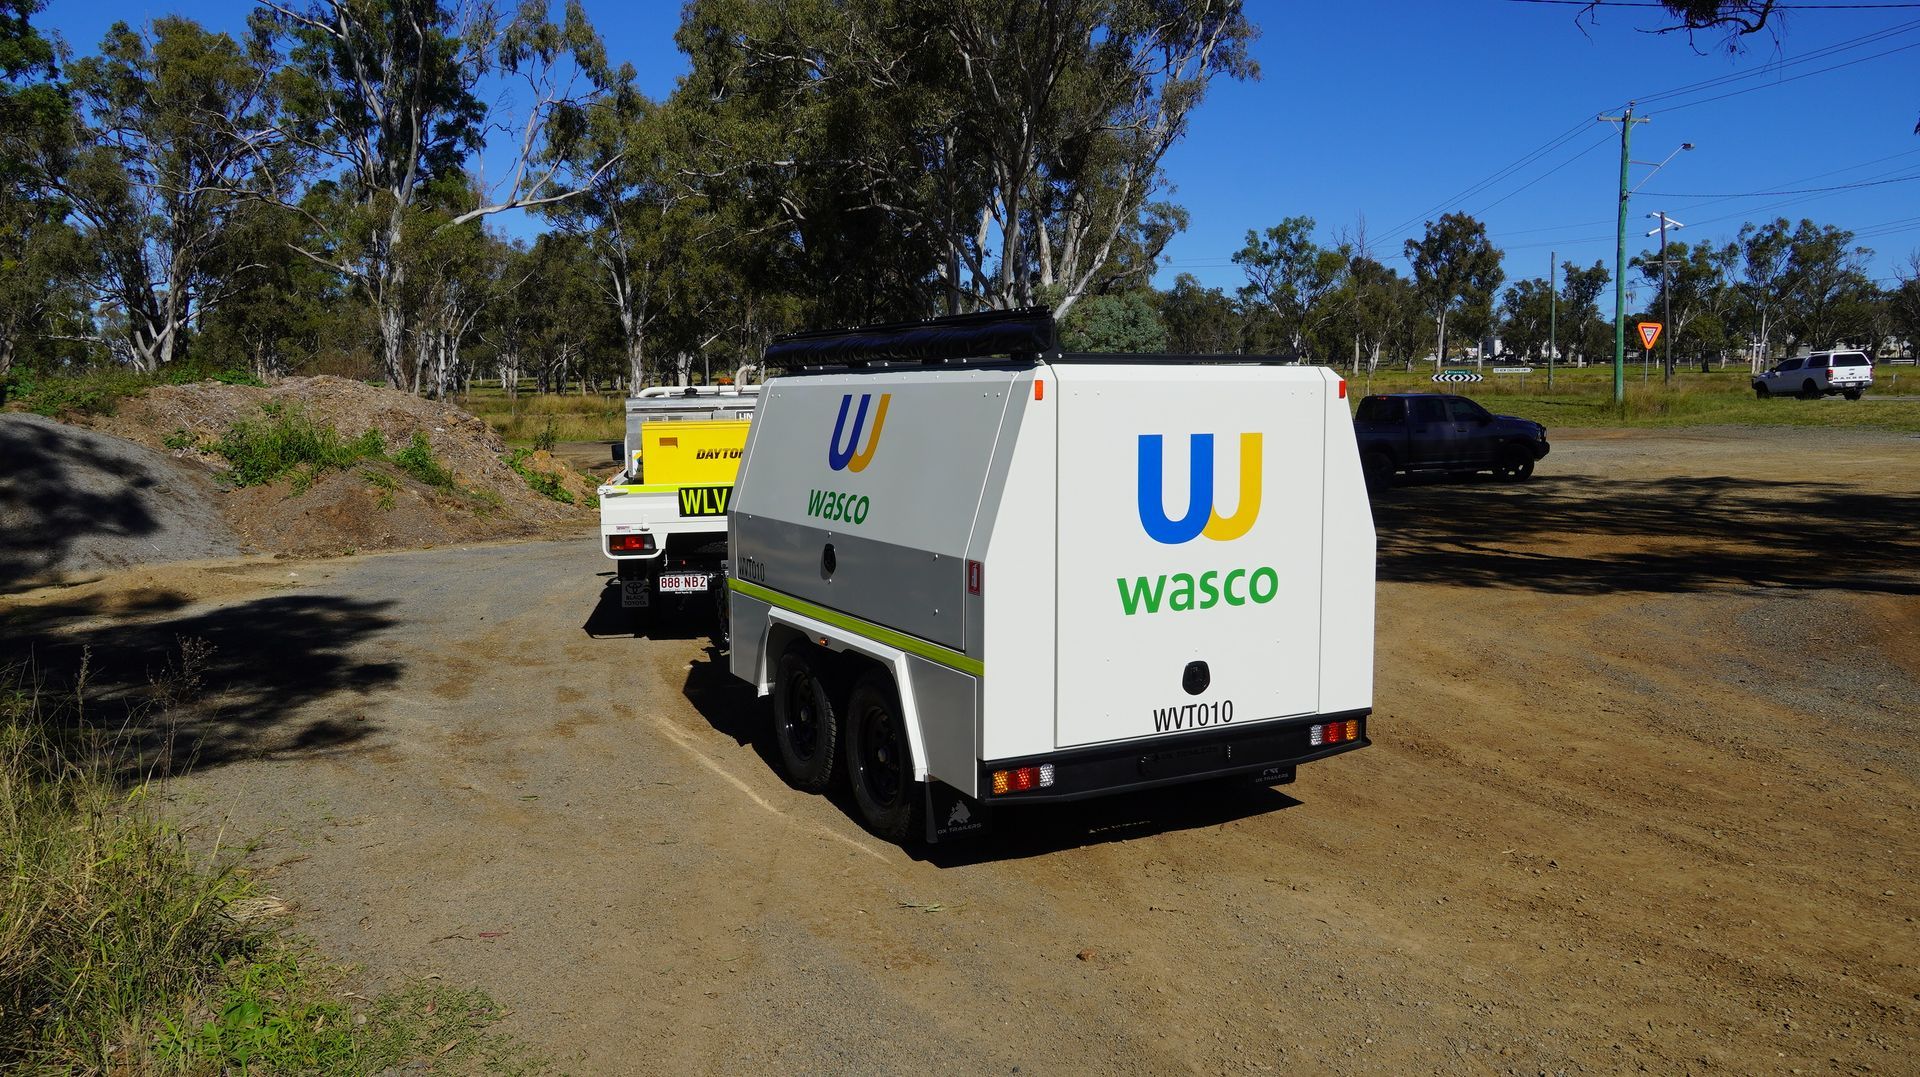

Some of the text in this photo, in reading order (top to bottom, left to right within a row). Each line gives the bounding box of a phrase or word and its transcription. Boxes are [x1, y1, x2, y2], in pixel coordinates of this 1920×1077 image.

[681, 489, 727, 514] WLV
[807, 489, 870, 525] wasco
[1116, 566, 1279, 616] wasco
[1153, 700, 1233, 732] WVT010
